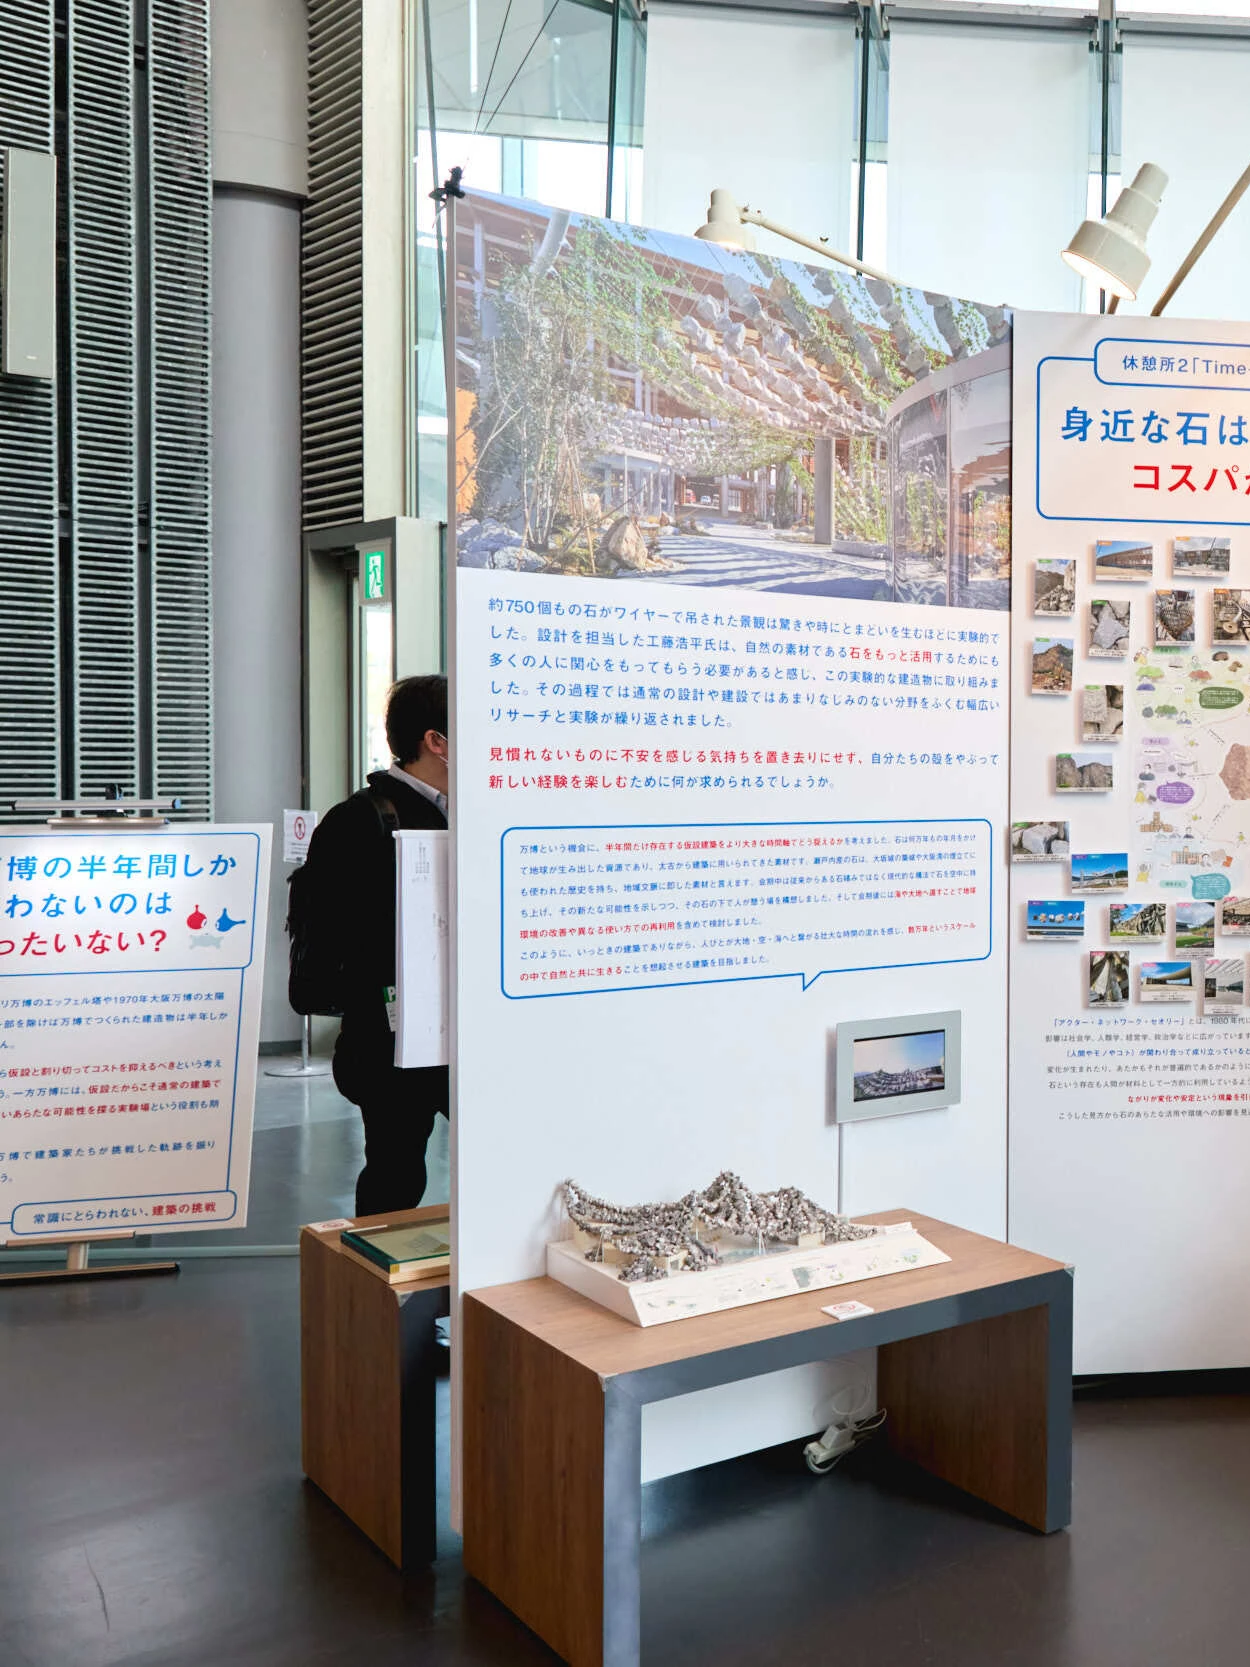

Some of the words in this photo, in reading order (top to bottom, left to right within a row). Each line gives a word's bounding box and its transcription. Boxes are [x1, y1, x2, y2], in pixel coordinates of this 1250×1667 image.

[491, 625, 998, 666] した。設計を担当した工藤浩平氏は、自然の素材である石をもっと活用するためにも
[489, 653, 998, 688] 多くの人に関心をもってもらう必要があると感じ、この実験的な建造物に取り組みま
[492, 680, 999, 711] した。その過程では通常の設計や建設ではあまりなじみのない分野をふくむ幅広い
[491, 708, 733, 728] リサーチと実験が繰り返されました。
[490, 747, 999, 766] 見慣れないものに不安を感じる気持ちを置き去りにせず、自分たちの殻をやぶって
[488, 775, 836, 791] 新しい経験を楽しむために何が求められるでしょうか。
[0, 854, 237, 882] 博の半年間しか
[4, 892, 172, 919] わないのは
[0, 1013, 228, 1029] 部を除けば万博でつくられた建造物は半年しか
[33, 1202, 216, 1224] 常識にとらわれない、建築の挑戦
